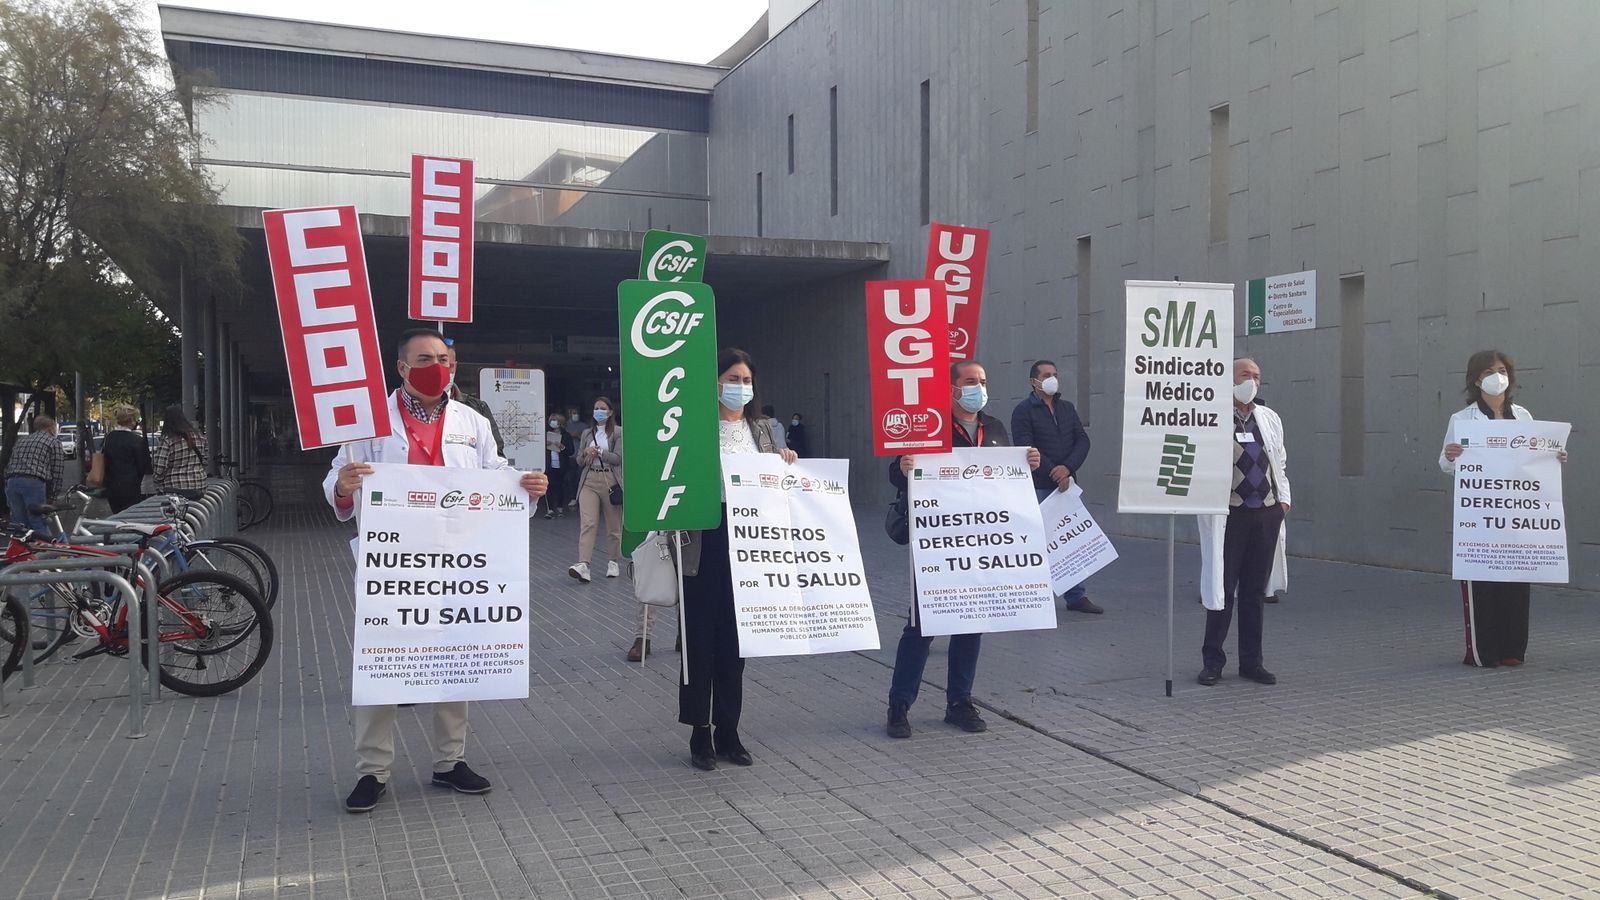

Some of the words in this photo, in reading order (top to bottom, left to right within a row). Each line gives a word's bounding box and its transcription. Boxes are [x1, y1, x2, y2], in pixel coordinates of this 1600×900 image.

[421, 159, 460, 318] CCOO
[283, 210, 375, 444] CCOO
[1141, 300, 1217, 348] SMA
[1283, 318, 1306, 326] URGENCIAS
[884, 288, 934, 405] UGT
[1135, 355, 1224, 376] Sindicato
[1146, 381, 1214, 401] Médico
[913, 414, 928, 422] FSP
[1140, 407, 1218, 427] Andaluz
[656, 368, 685, 520] CSIF
[1460, 479, 1540, 491] NUESTROS
[914, 500, 938, 508] POR
[1461, 497, 1540, 509] DERECHOS
[733, 508, 758, 517] POR
[916, 511, 1009, 528] NUESTROS
[1483, 517, 1505, 529] TU
[1512, 518, 1560, 530] SALUD
[367, 532, 400, 542] POR
[734, 526, 825, 540] NUESTROS
[1059, 519, 1092, 545] SALUD
[920, 532, 1014, 549] DERECHOS
[1021, 535, 1028, 543] Y
[366, 553, 486, 568] NUESTROS
[737, 550, 831, 563] DERECHOS
[946, 557, 971, 571] TU
[979, 553, 1042, 570] SALUD
[367, 580, 489, 595] DERECHOS
[498, 584, 506, 593] Y
[764, 574, 789, 587] TU
[797, 573, 861, 588] SALUD
[398, 609, 429, 625] TU
[440, 606, 522, 624] SALUD
[422, 644, 478, 653] DEROGACIÓN
[468, 668, 512, 676] SANITARIO
[405, 678, 439, 686] PÚBLICO
